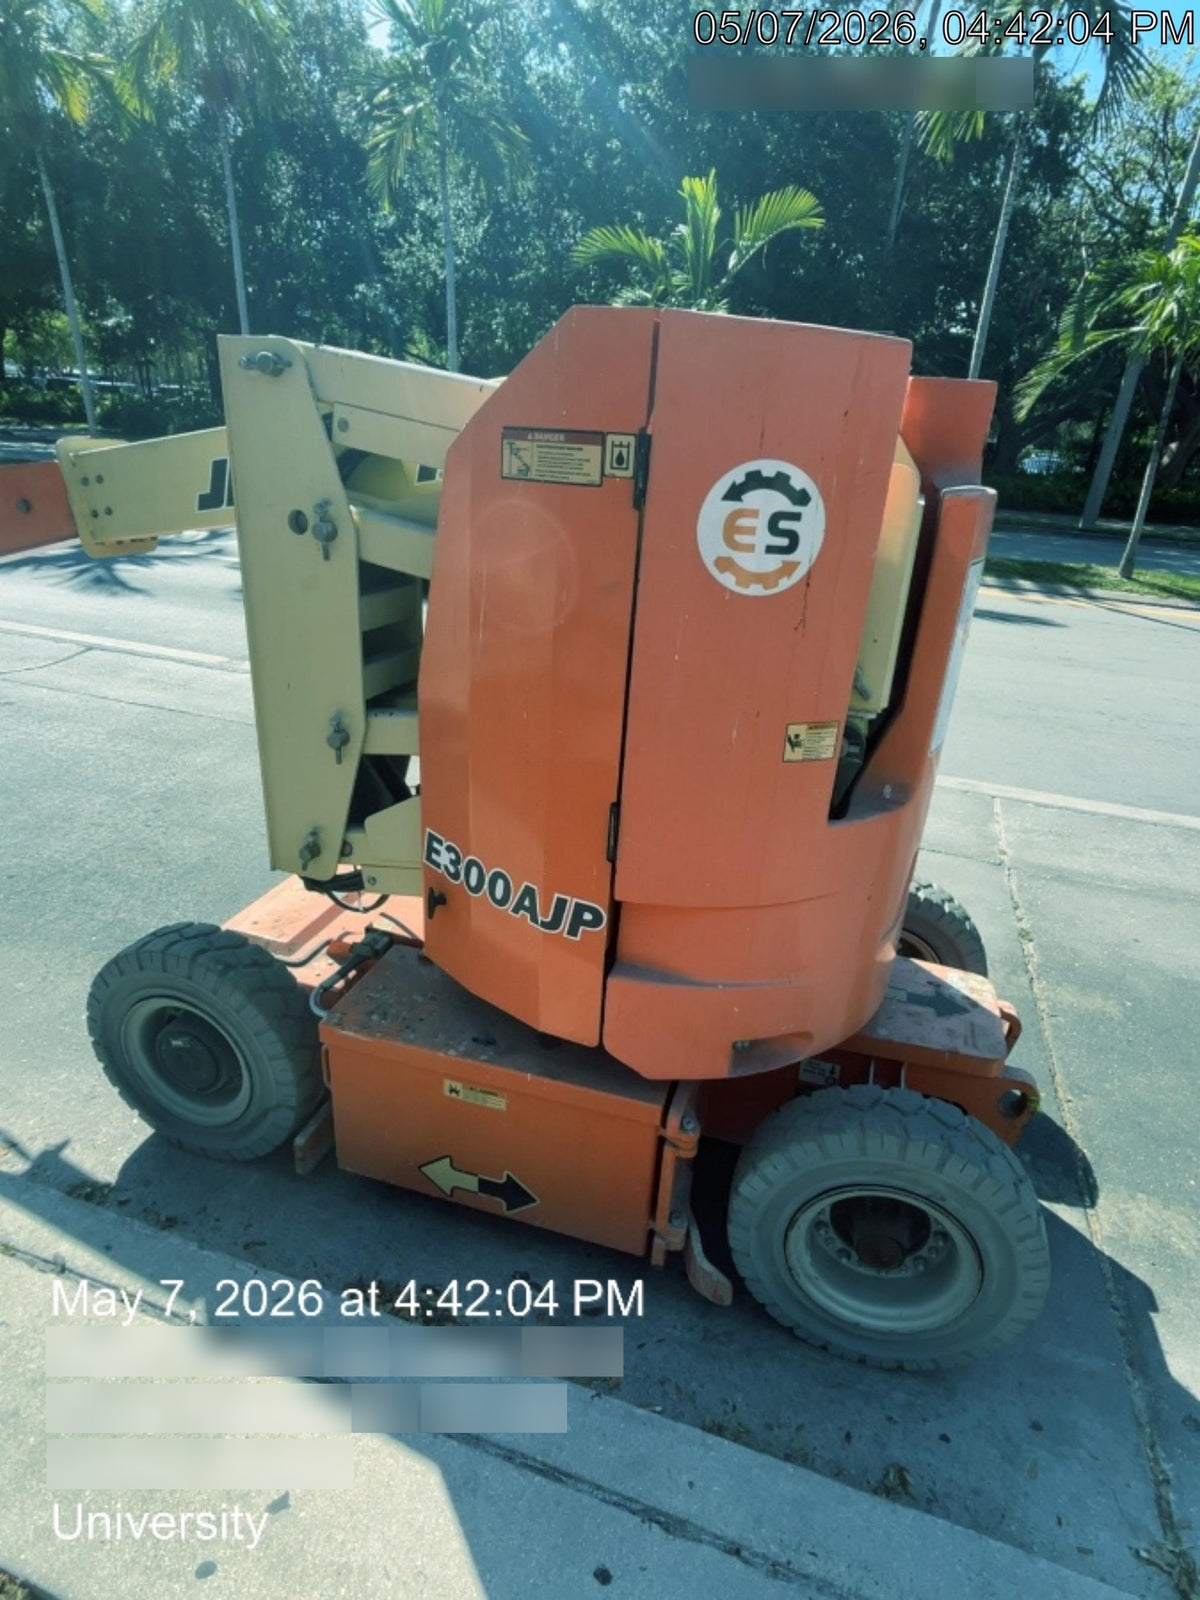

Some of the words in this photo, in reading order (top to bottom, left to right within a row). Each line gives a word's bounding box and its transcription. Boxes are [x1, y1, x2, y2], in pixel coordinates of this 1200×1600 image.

[195, 456, 236, 512] J
[722, 507, 802, 555] ES
[423, 828, 606, 941] E300AJP
